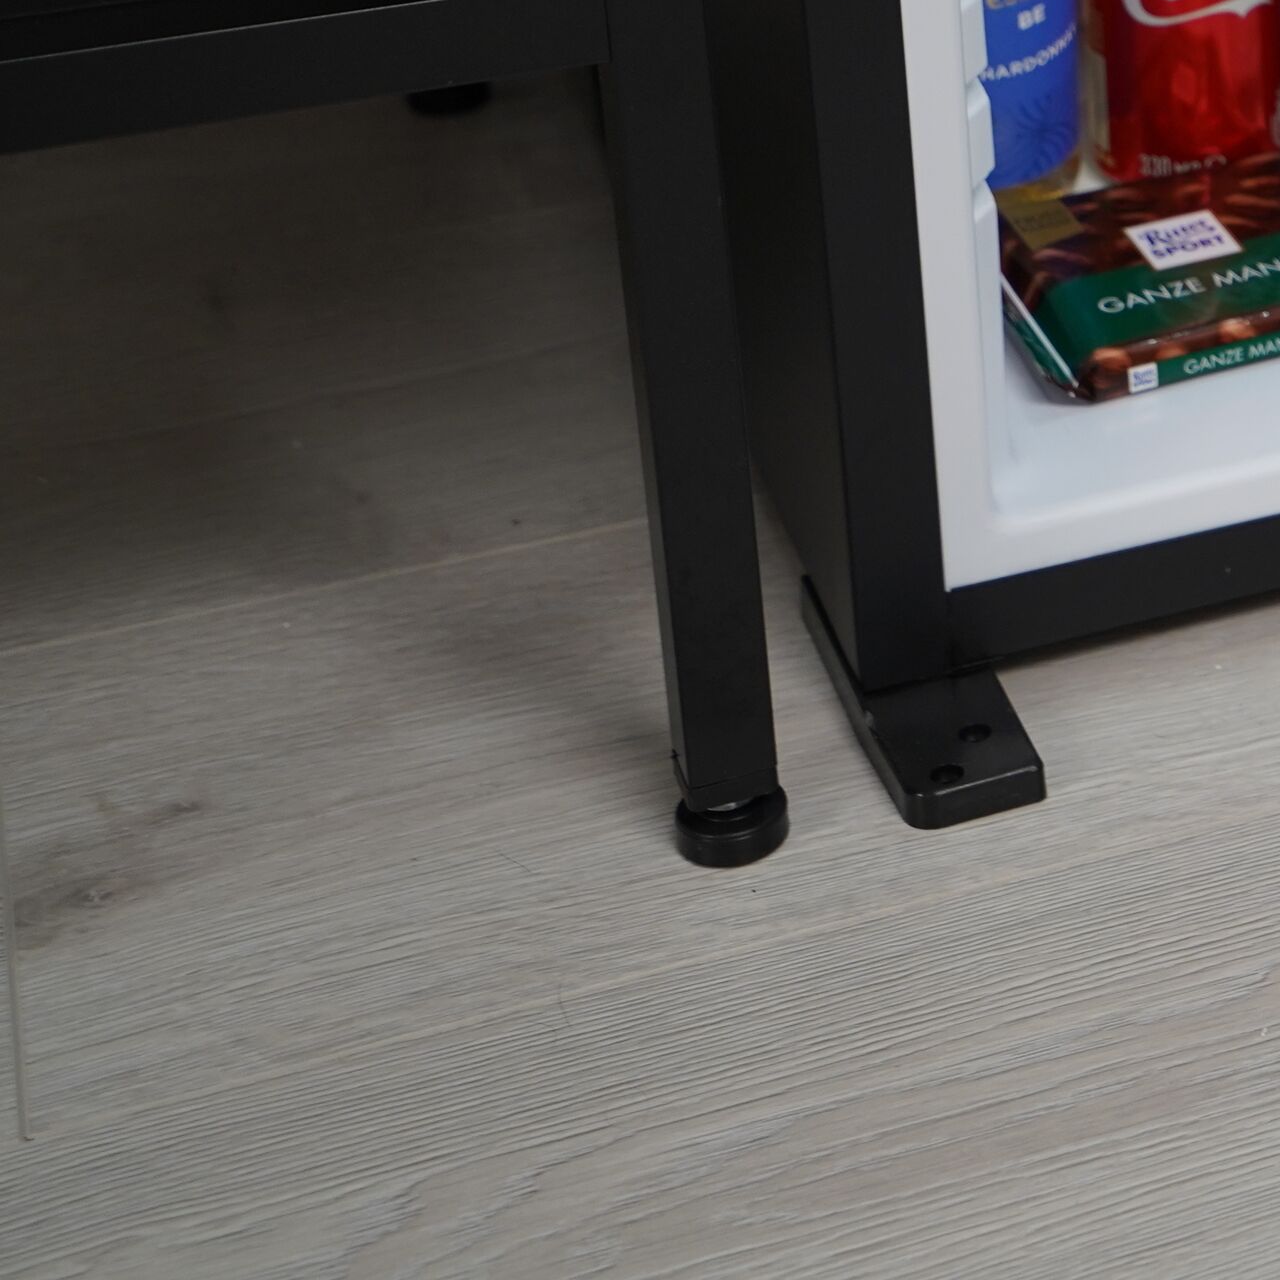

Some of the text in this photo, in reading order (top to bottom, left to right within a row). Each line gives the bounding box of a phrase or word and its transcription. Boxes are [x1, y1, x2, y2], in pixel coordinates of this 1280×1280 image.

[1152, 233, 1227, 260] SPORT
[1097, 276, 1207, 314] GANZE
[1183, 344, 1245, 375] GANZE
